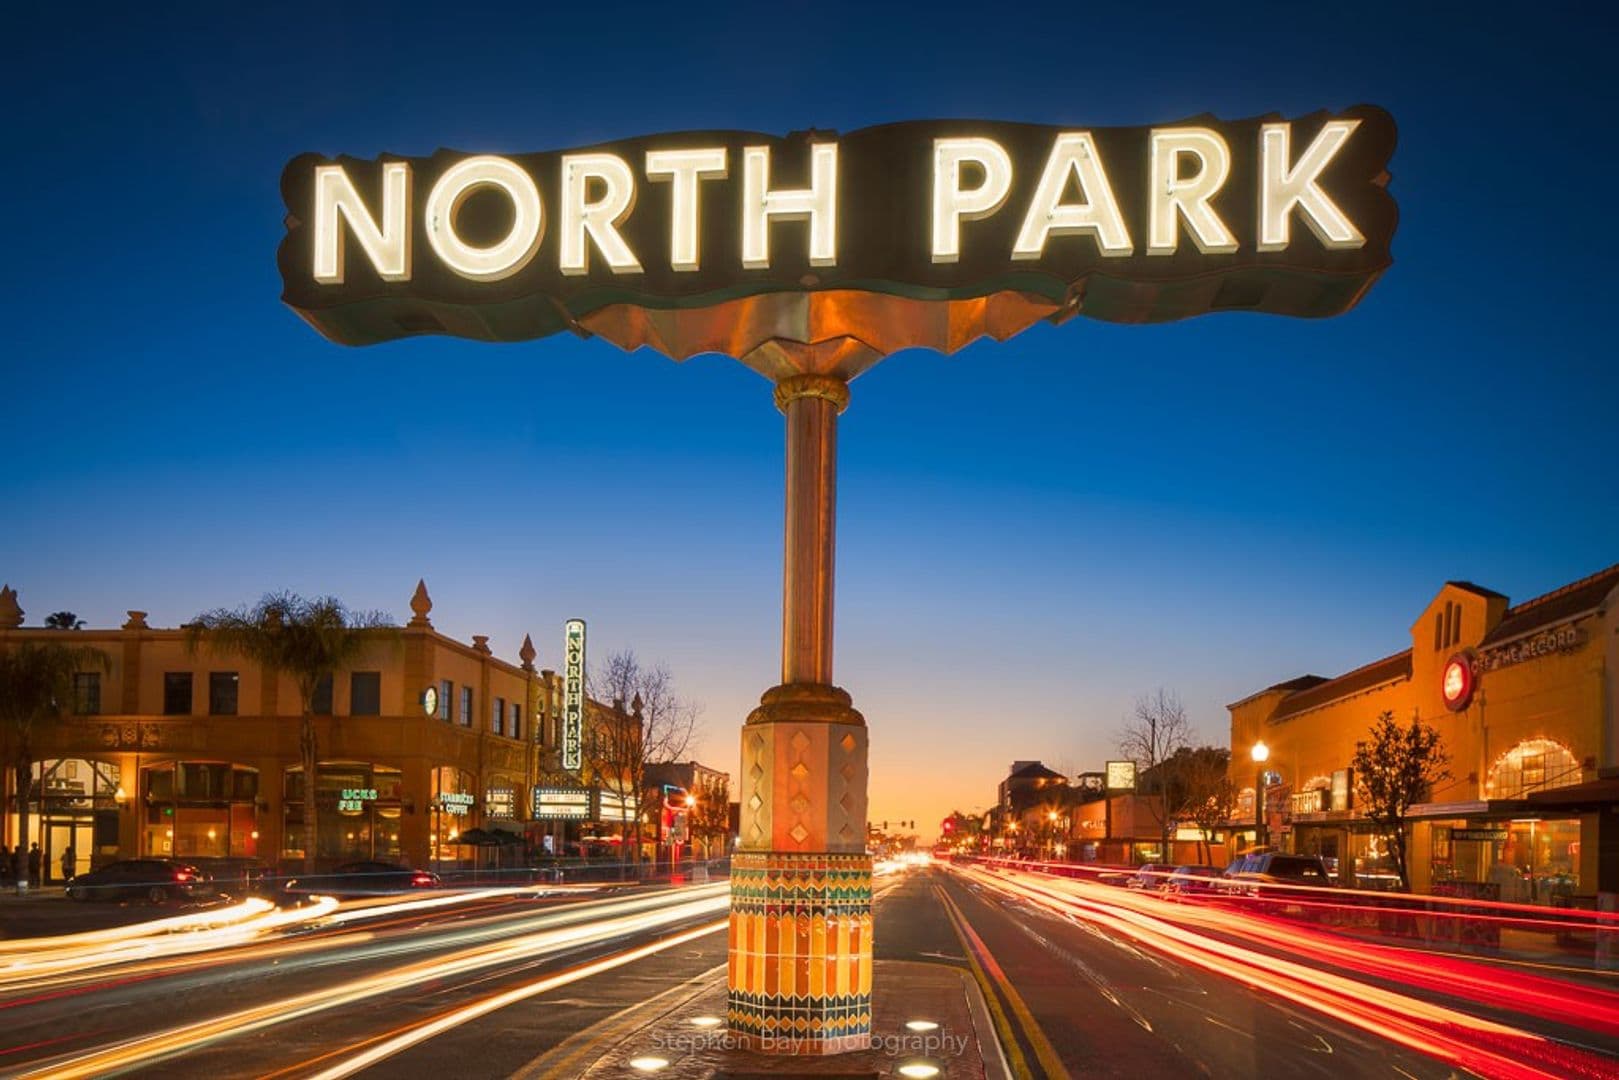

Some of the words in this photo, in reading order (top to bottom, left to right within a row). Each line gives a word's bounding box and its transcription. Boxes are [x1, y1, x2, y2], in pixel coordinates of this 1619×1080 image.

[314, 142, 838, 284] NORTH
[931, 119, 1368, 263] PARK
[567, 637, 581, 705] NORTH
[566, 711, 579, 766] PARK
